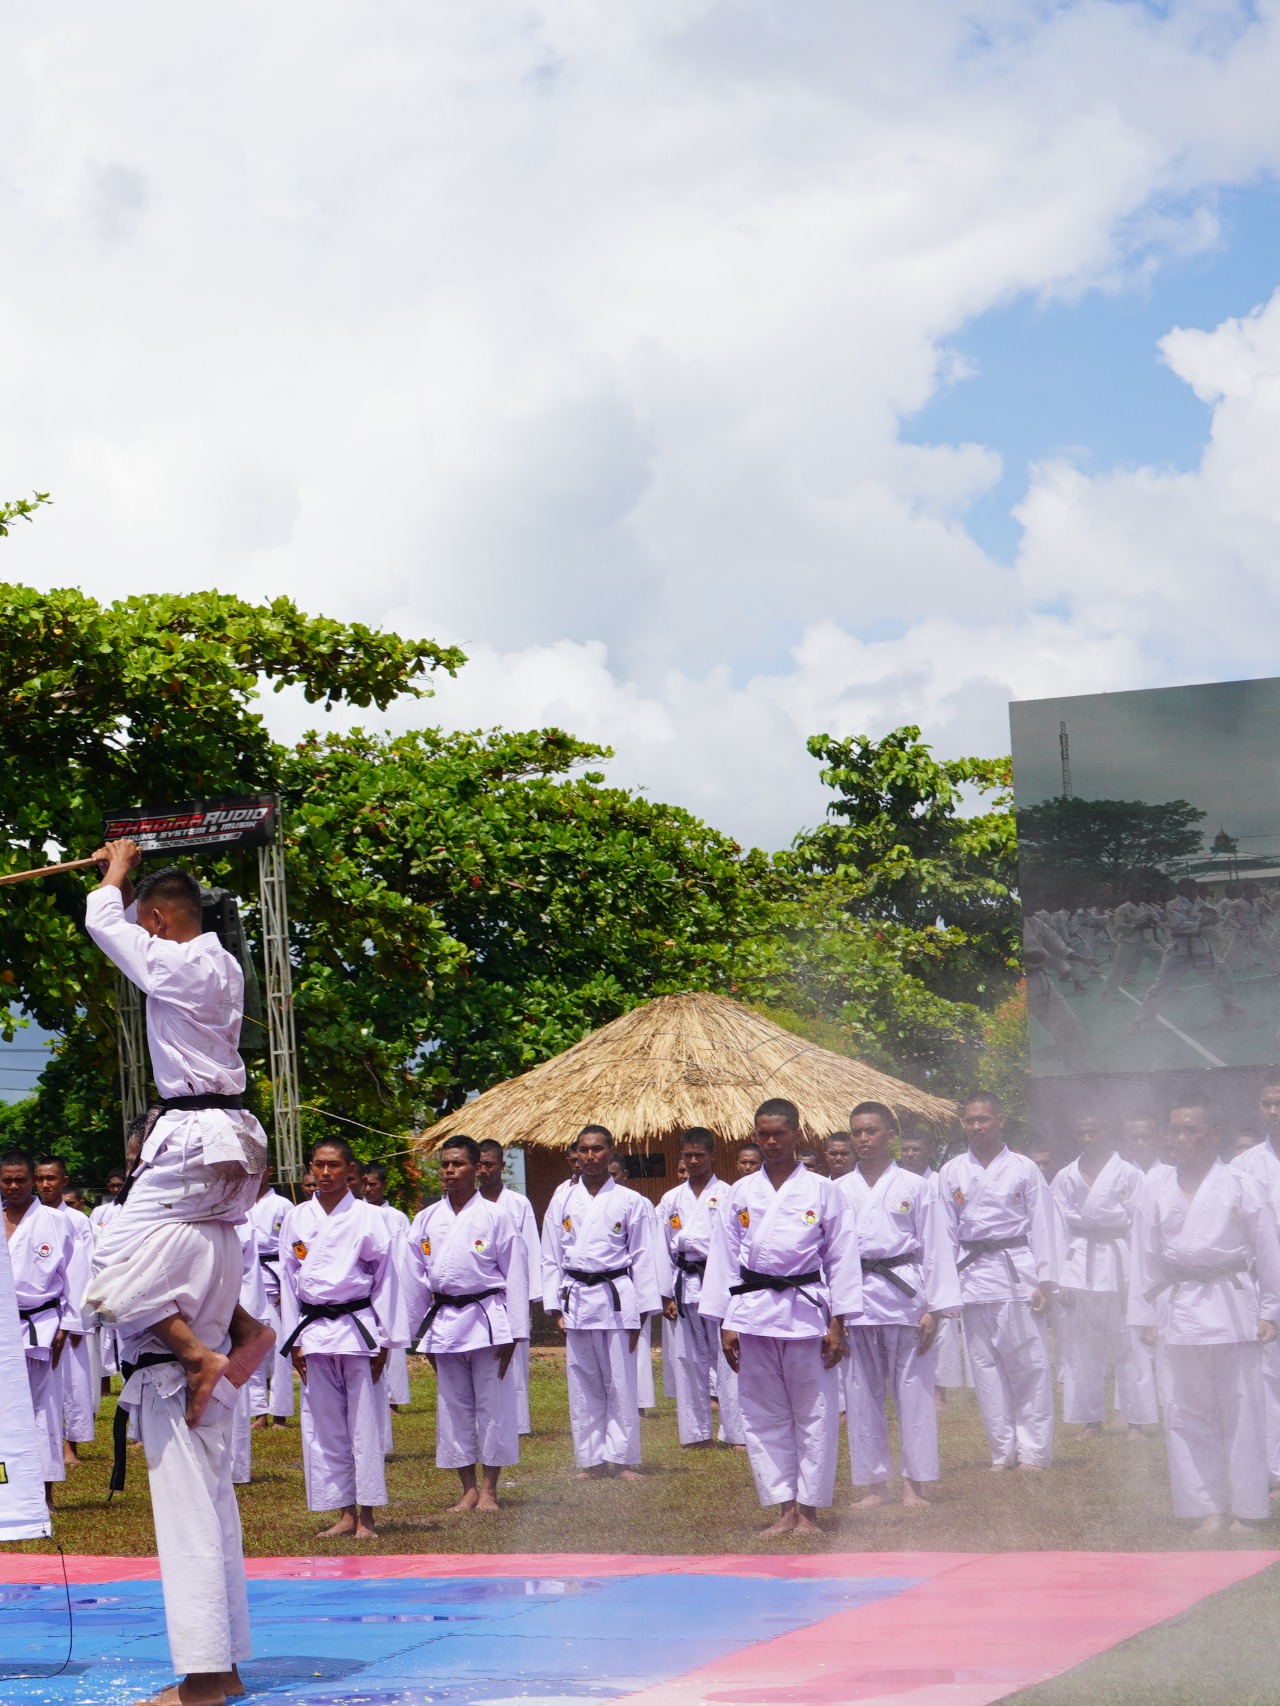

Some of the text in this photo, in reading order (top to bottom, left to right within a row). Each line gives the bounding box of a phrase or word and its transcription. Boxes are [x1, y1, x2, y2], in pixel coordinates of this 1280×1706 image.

[203, 808, 269, 825] AUDIO
[159, 827, 206, 839] SYSTEM
[208, 825, 218, 833] &
[221, 821, 258, 831] MUSIK
